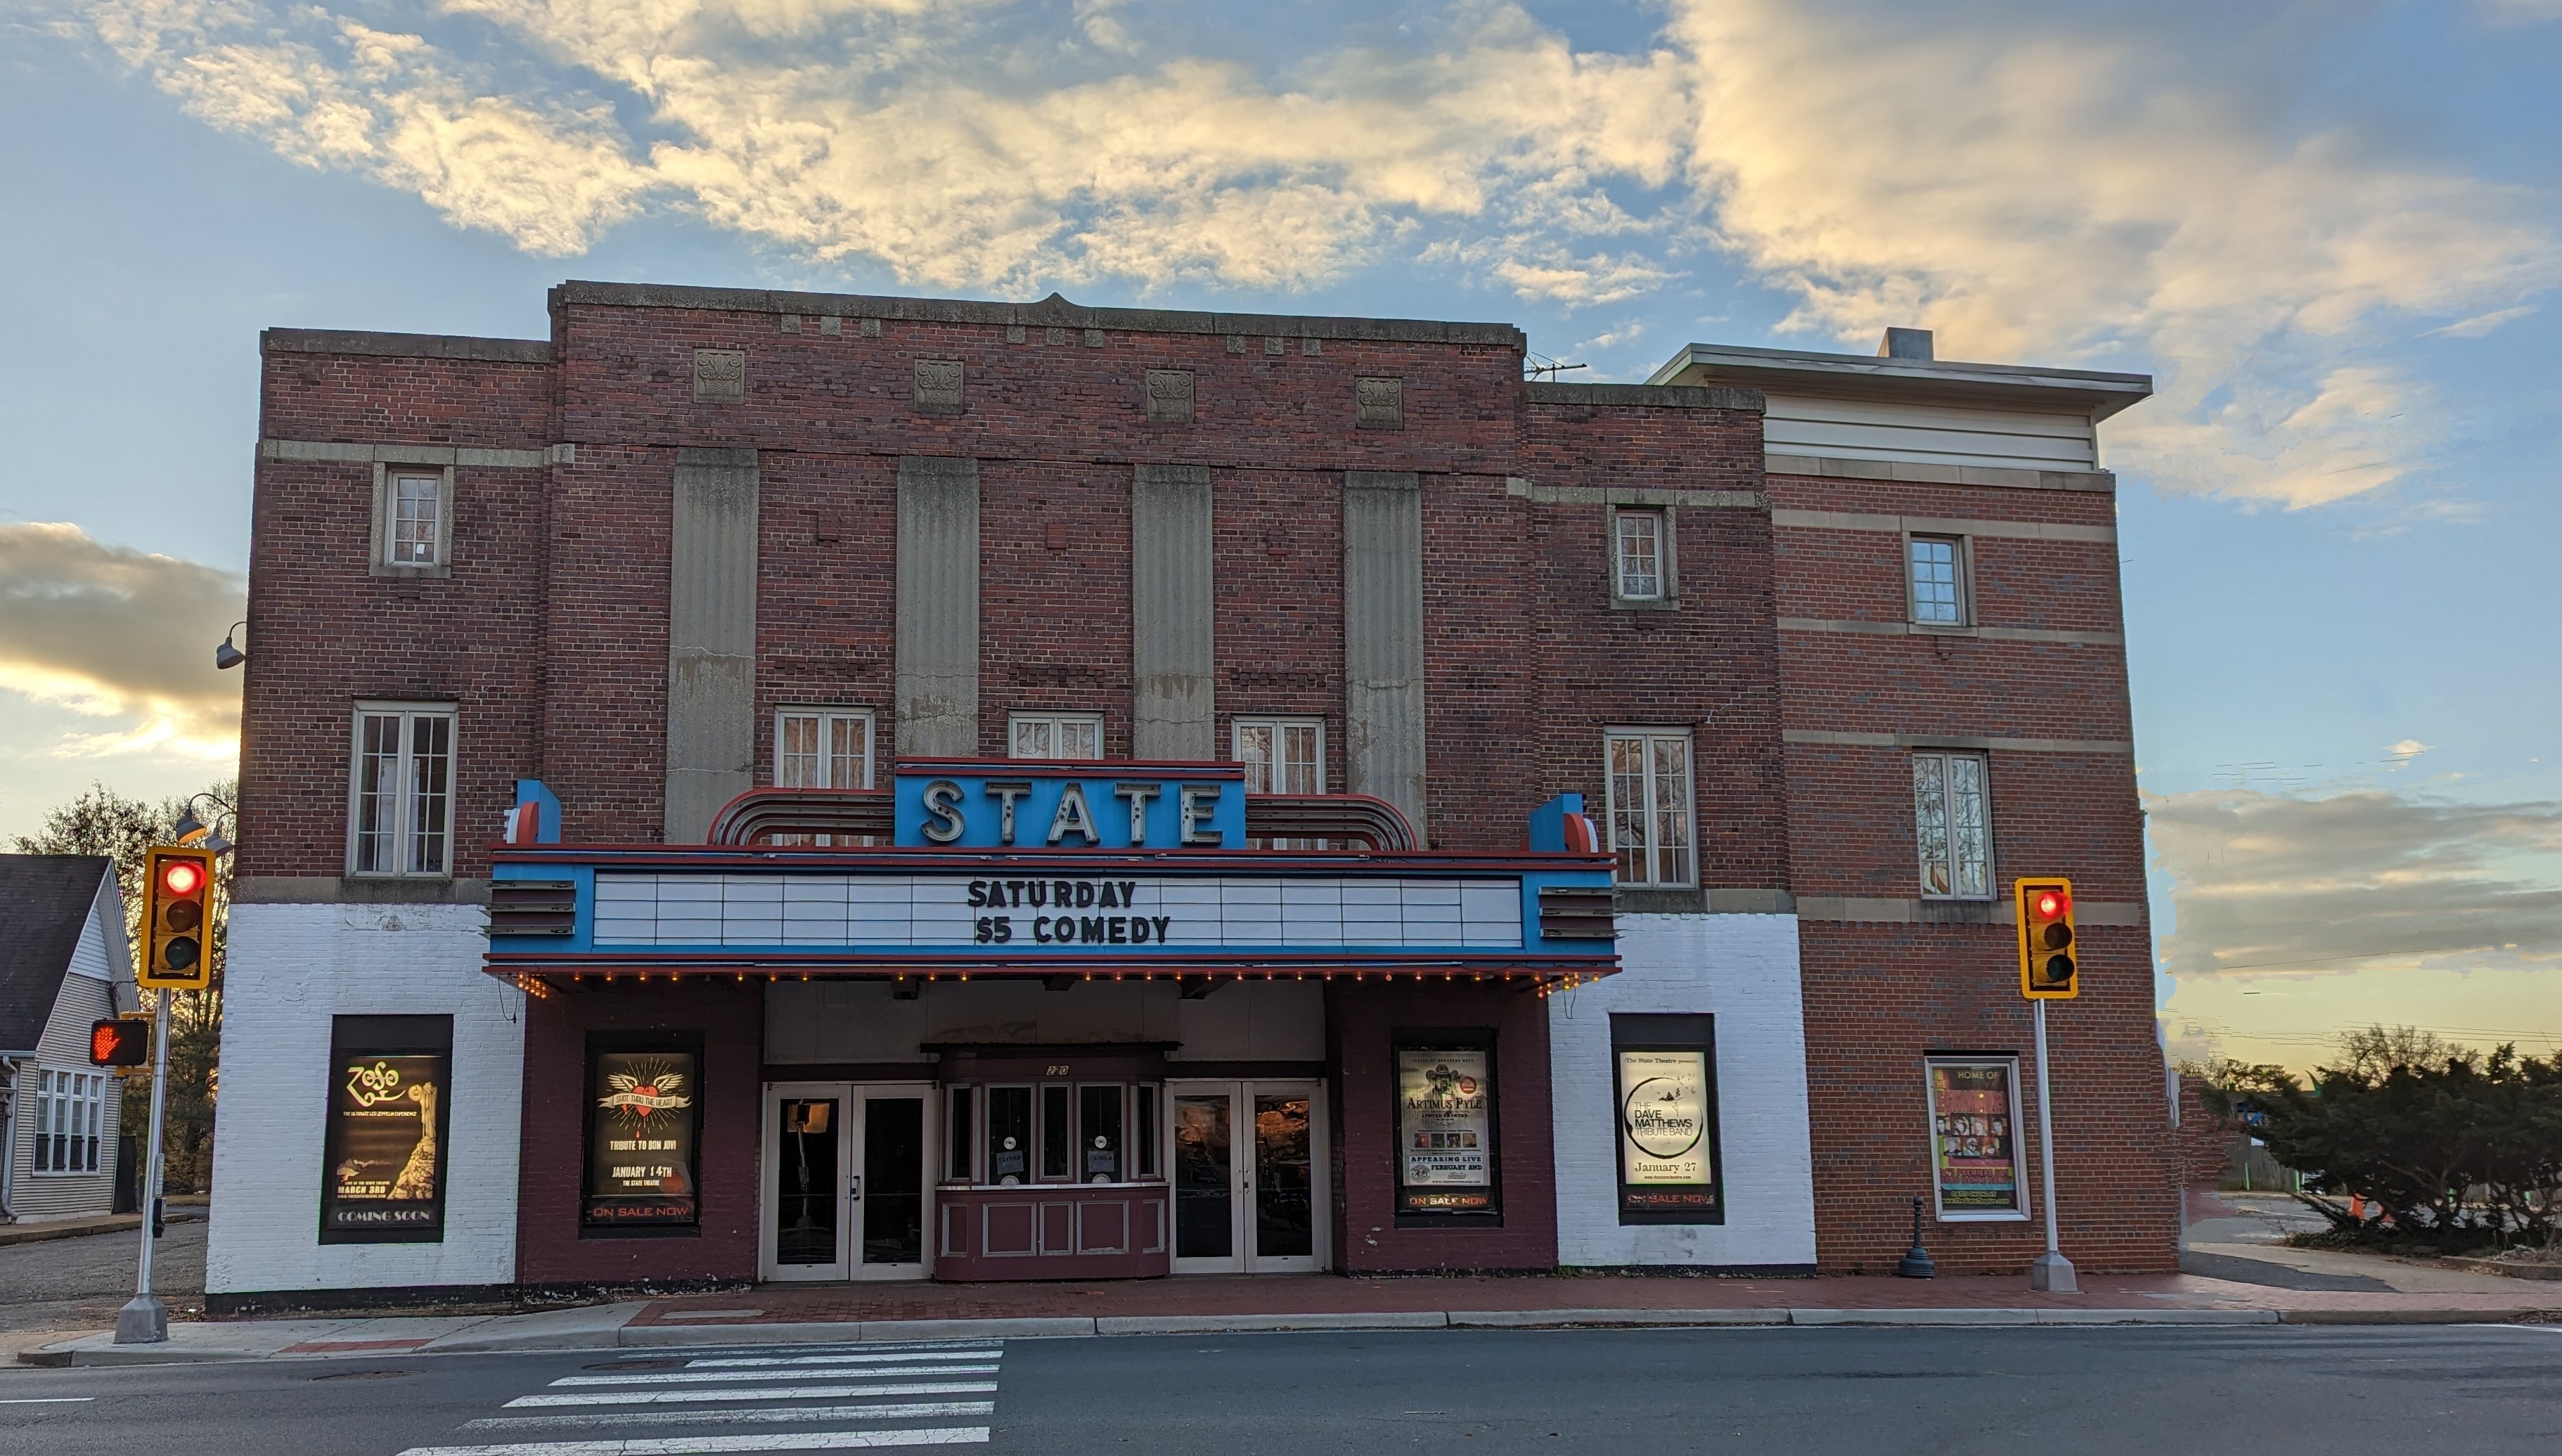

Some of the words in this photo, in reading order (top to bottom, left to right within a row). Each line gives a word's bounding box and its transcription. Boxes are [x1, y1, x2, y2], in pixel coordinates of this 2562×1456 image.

[920, 779, 1223, 845] STATE
[967, 880, 1136, 908] SATURDAY
[976, 916, 1012, 943] $5
[1034, 916, 1171, 944] COMEDY
[1048, 1066, 1068, 1075] 220
[1957, 1071, 1985, 1079] HOME
[1987, 1071, 2000, 1079] OF
[616, 1095, 629, 1104] SHOT
[631, 1095, 644, 1104] THRU
[645, 1096, 655, 1106] THE
[656, 1096, 673, 1107] HEART
[1407, 1097, 1453, 1109] ARTIMUS
[1454, 1097, 1482, 1109] PYLE
[1634, 1102, 1652, 1110] THE
[1635, 1110, 1662, 1119] DAVE
[1635, 1119, 1692, 1128] MATTHEWS
[1635, 1128, 1668, 1136] TRIBUTE
[1669, 1128, 1693, 1136] BAND
[610, 1140, 636, 1150] TRIBUTE
[638, 1140, 646, 1150] TO
[648, 1140, 662, 1150] BON
[663, 1140, 676, 1150] JOVI
[612, 1166, 645, 1178] JANUARY
[1635, 1162, 1680, 1174] January
[1684, 1162, 1697, 1172] 27
[1957, 1168, 1993, 1177] PREMIERE
[1409, 1197, 1426, 1206] ON
[1649, 1194, 1680, 1204] SALE
[337, 1211, 392, 1223] COMING
[394, 1210, 430, 1221] SOON
[593, 1207, 614, 1217] ON
[618, 1207, 652, 1216] SALE
[657, 1206, 688, 1216] NOW
